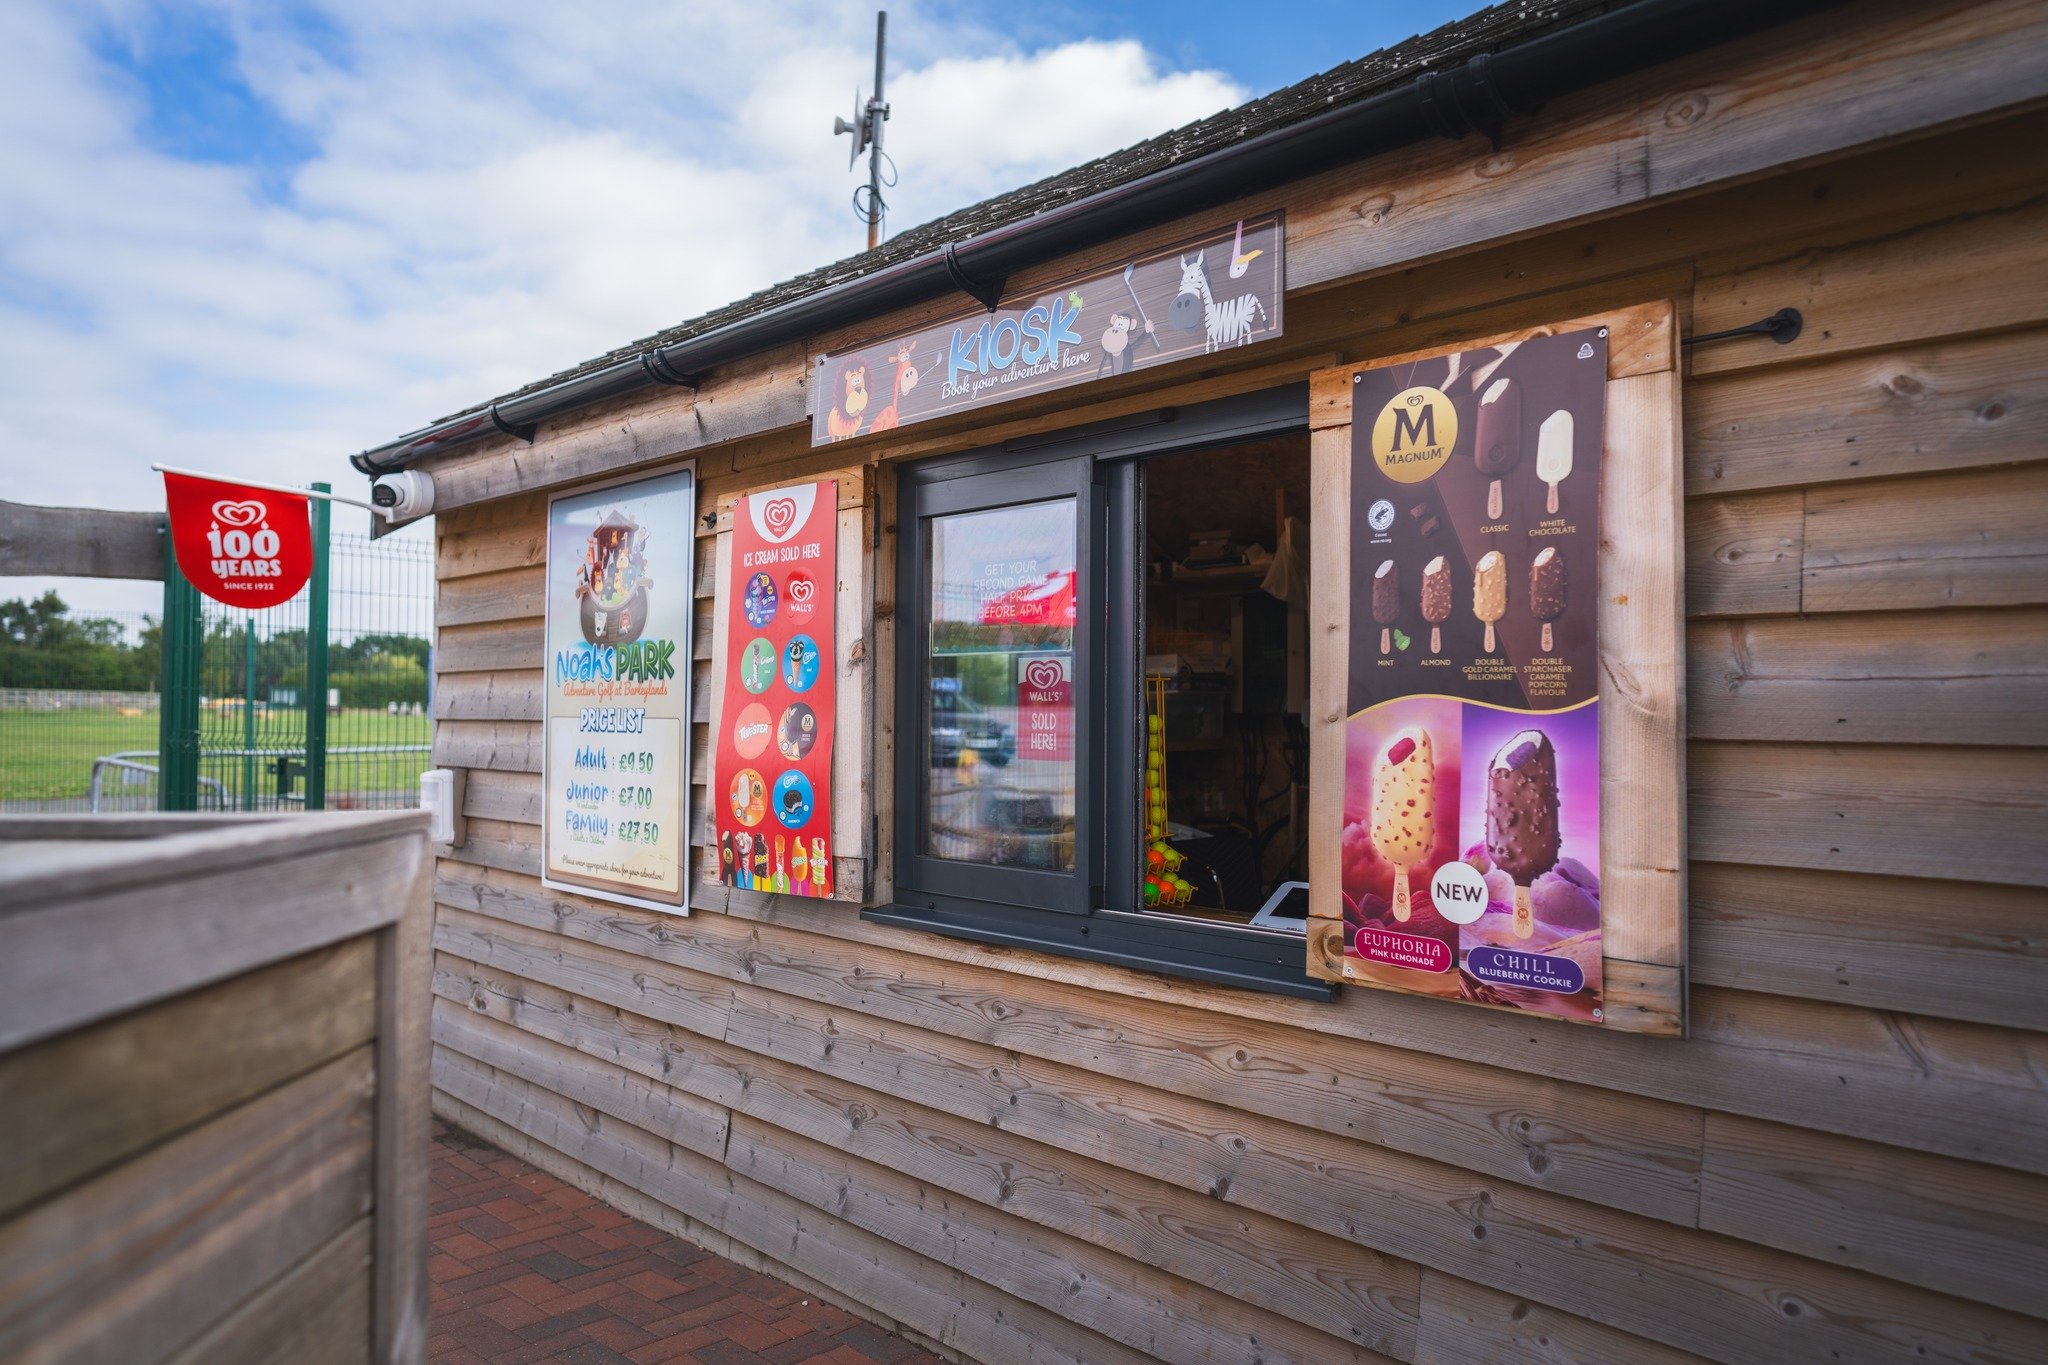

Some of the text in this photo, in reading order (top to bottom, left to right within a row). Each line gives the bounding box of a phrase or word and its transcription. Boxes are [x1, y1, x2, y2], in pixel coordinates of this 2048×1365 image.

[948, 297, 1082, 388] KIOSK
[941, 348, 1091, 399] Book your adventure here
[1390, 404, 1438, 452] M
[1385, 449, 1443, 465] MAGNUM
[1480, 524, 1510, 534] CLASSIC
[1528, 526, 1577, 537] CHOCOLATE
[1539, 519, 1566, 528] WHITE
[207, 529, 280, 558] 100
[743, 543, 821, 567] ICE CREAM SOLD HERE
[211, 559, 282, 579] YEARS
[984, 560, 1037, 576] GET YOUR
[224, 582, 253, 590] SINCE
[974, 574, 1048, 591] SECOND GAME
[790, 603, 812, 612] WALL'S
[980, 591, 1006, 605] HALF
[978, 603, 1043, 618] BEFORE 4PM
[616, 640, 675, 683] PARK
[1377, 659, 1394, 667] MINT
[597, 682, 614, 703] Golf
[1029, 691, 1060, 701] WALL'S
[580, 707, 646, 734] PRICE LIST
[1031, 713, 1057, 730] SOLD
[1031, 733, 1057, 751] HERE!
[575, 745, 607, 770] Adult
[619, 752, 654, 772] £9.50
[566, 780, 608, 801] Junior
[619, 786, 652, 807] £7.00
[565, 810, 608, 836] Family
[619, 820, 659, 843] £27.50
[1436, 882, 1483, 903] NEW
[1363, 932, 1442, 957] EUPHORIA
[1370, 948, 1435, 967] PINK LEMONADE
[1493, 953, 1555, 975] CHILL
[1479, 966, 1572, 988] BLUEBERRY COOKIE
